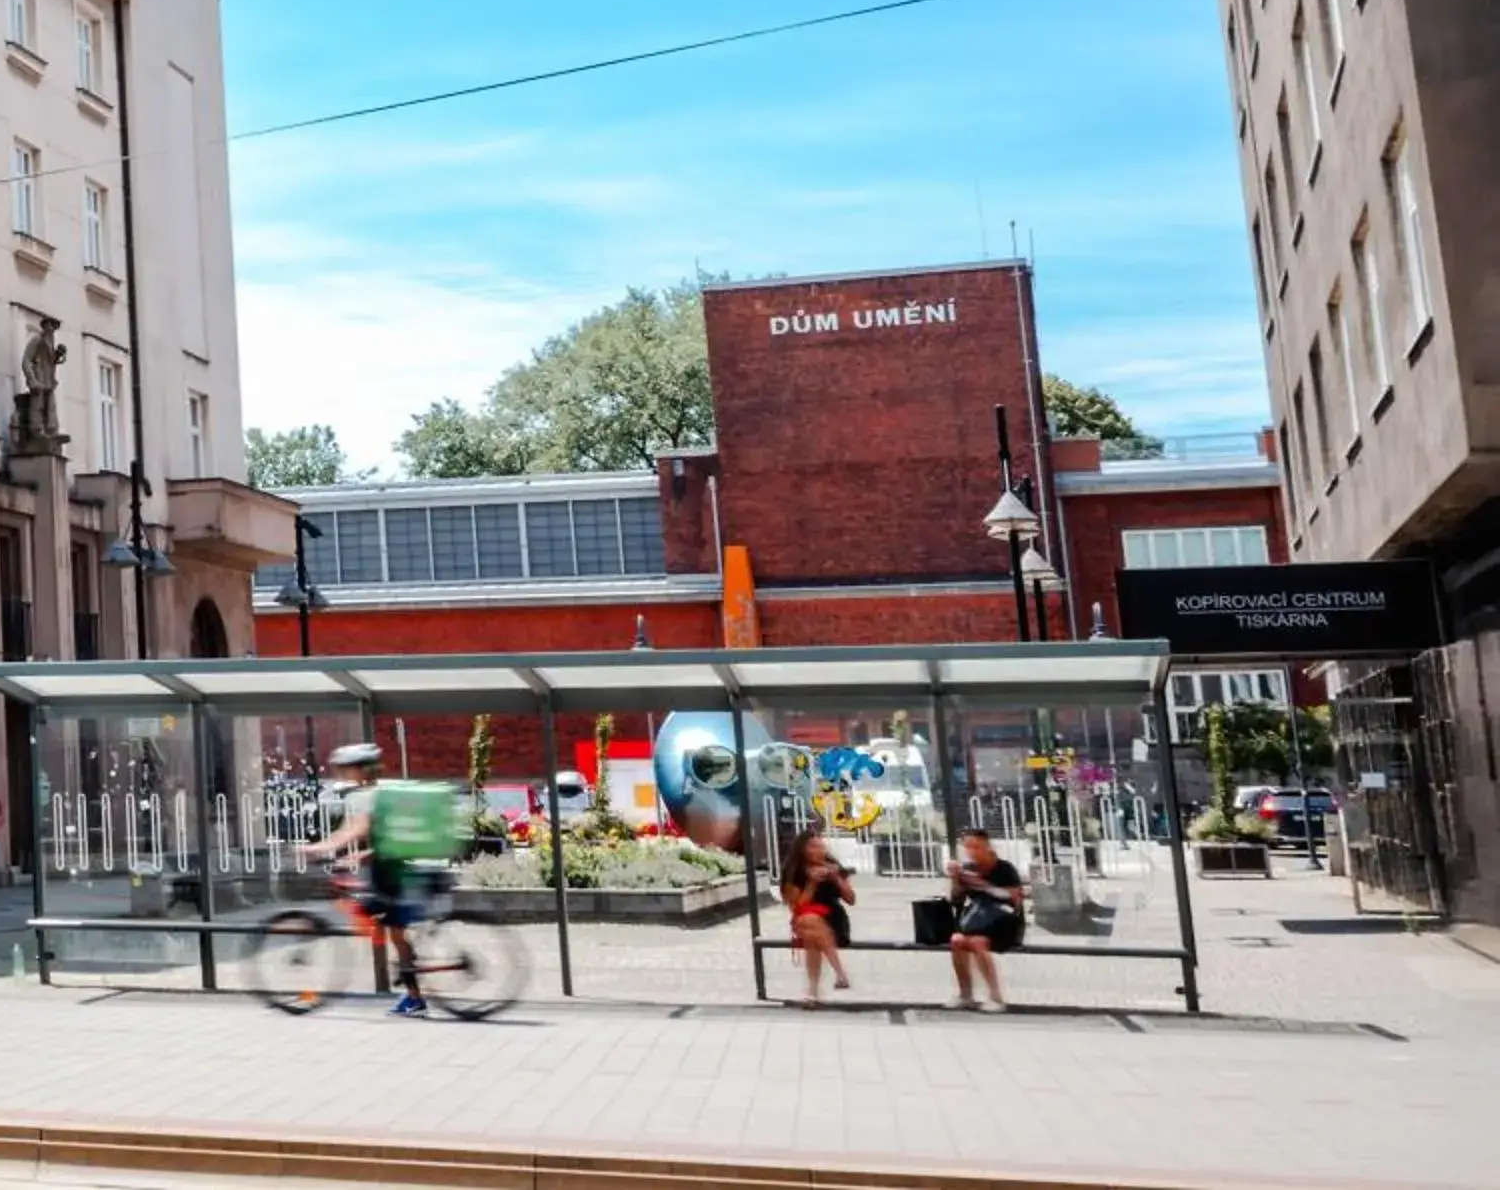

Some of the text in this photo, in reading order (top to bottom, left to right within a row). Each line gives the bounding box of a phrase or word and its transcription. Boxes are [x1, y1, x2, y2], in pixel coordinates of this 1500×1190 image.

[770, 298, 957, 335] DŮM UMĚNÍ
[1175, 591, 1386, 610] KOPÍROVACÍ CENTRUM
